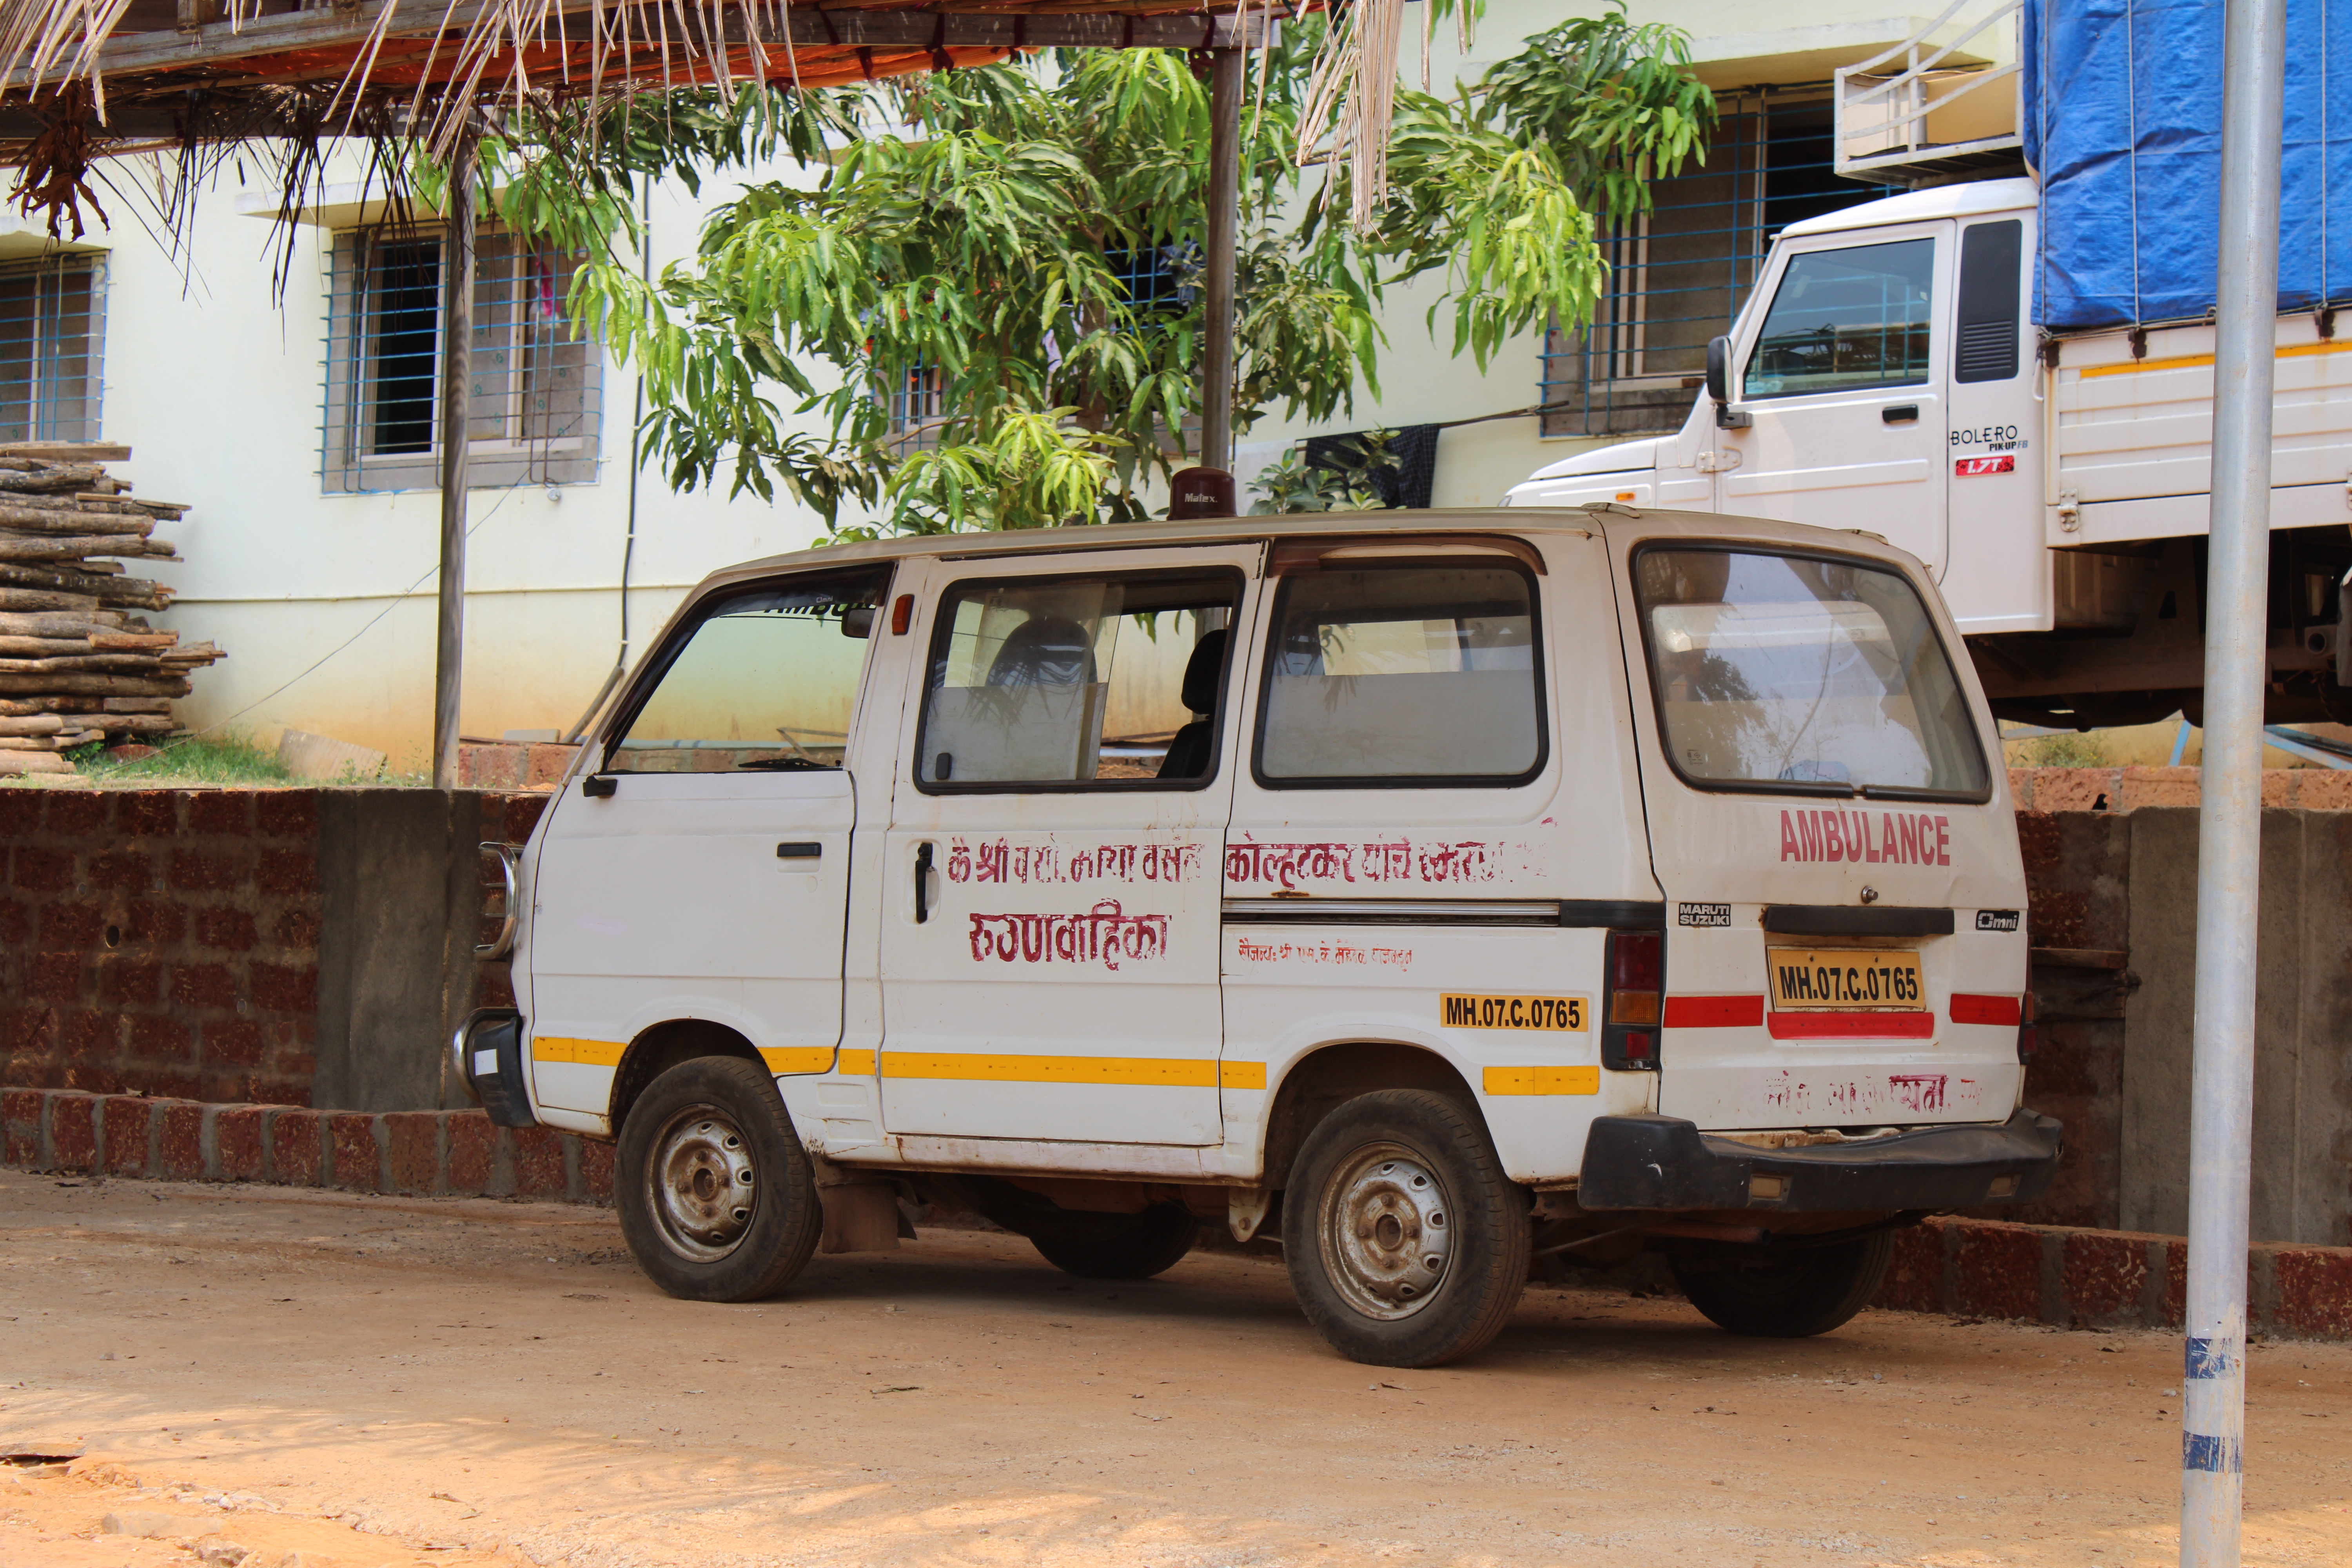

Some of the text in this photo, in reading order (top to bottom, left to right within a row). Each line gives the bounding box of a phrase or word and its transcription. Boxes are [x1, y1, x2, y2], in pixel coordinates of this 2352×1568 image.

[1951, 425, 2018, 445] BOLERO
[1989, 442, 2016, 451] PIK-UP
[1967, 459, 2003, 474] 1.7T
[1781, 810, 1950, 866] AMBULANCE
[1680, 904, 1730, 915] MARUTI
[1680, 915, 1730, 925] SUZUKI
[1978, 913, 2017, 929] Omni
[1779, 966, 1918, 1001] MH.07.C.0765
[1446, 997, 1580, 1029] MH.07.C.0765
